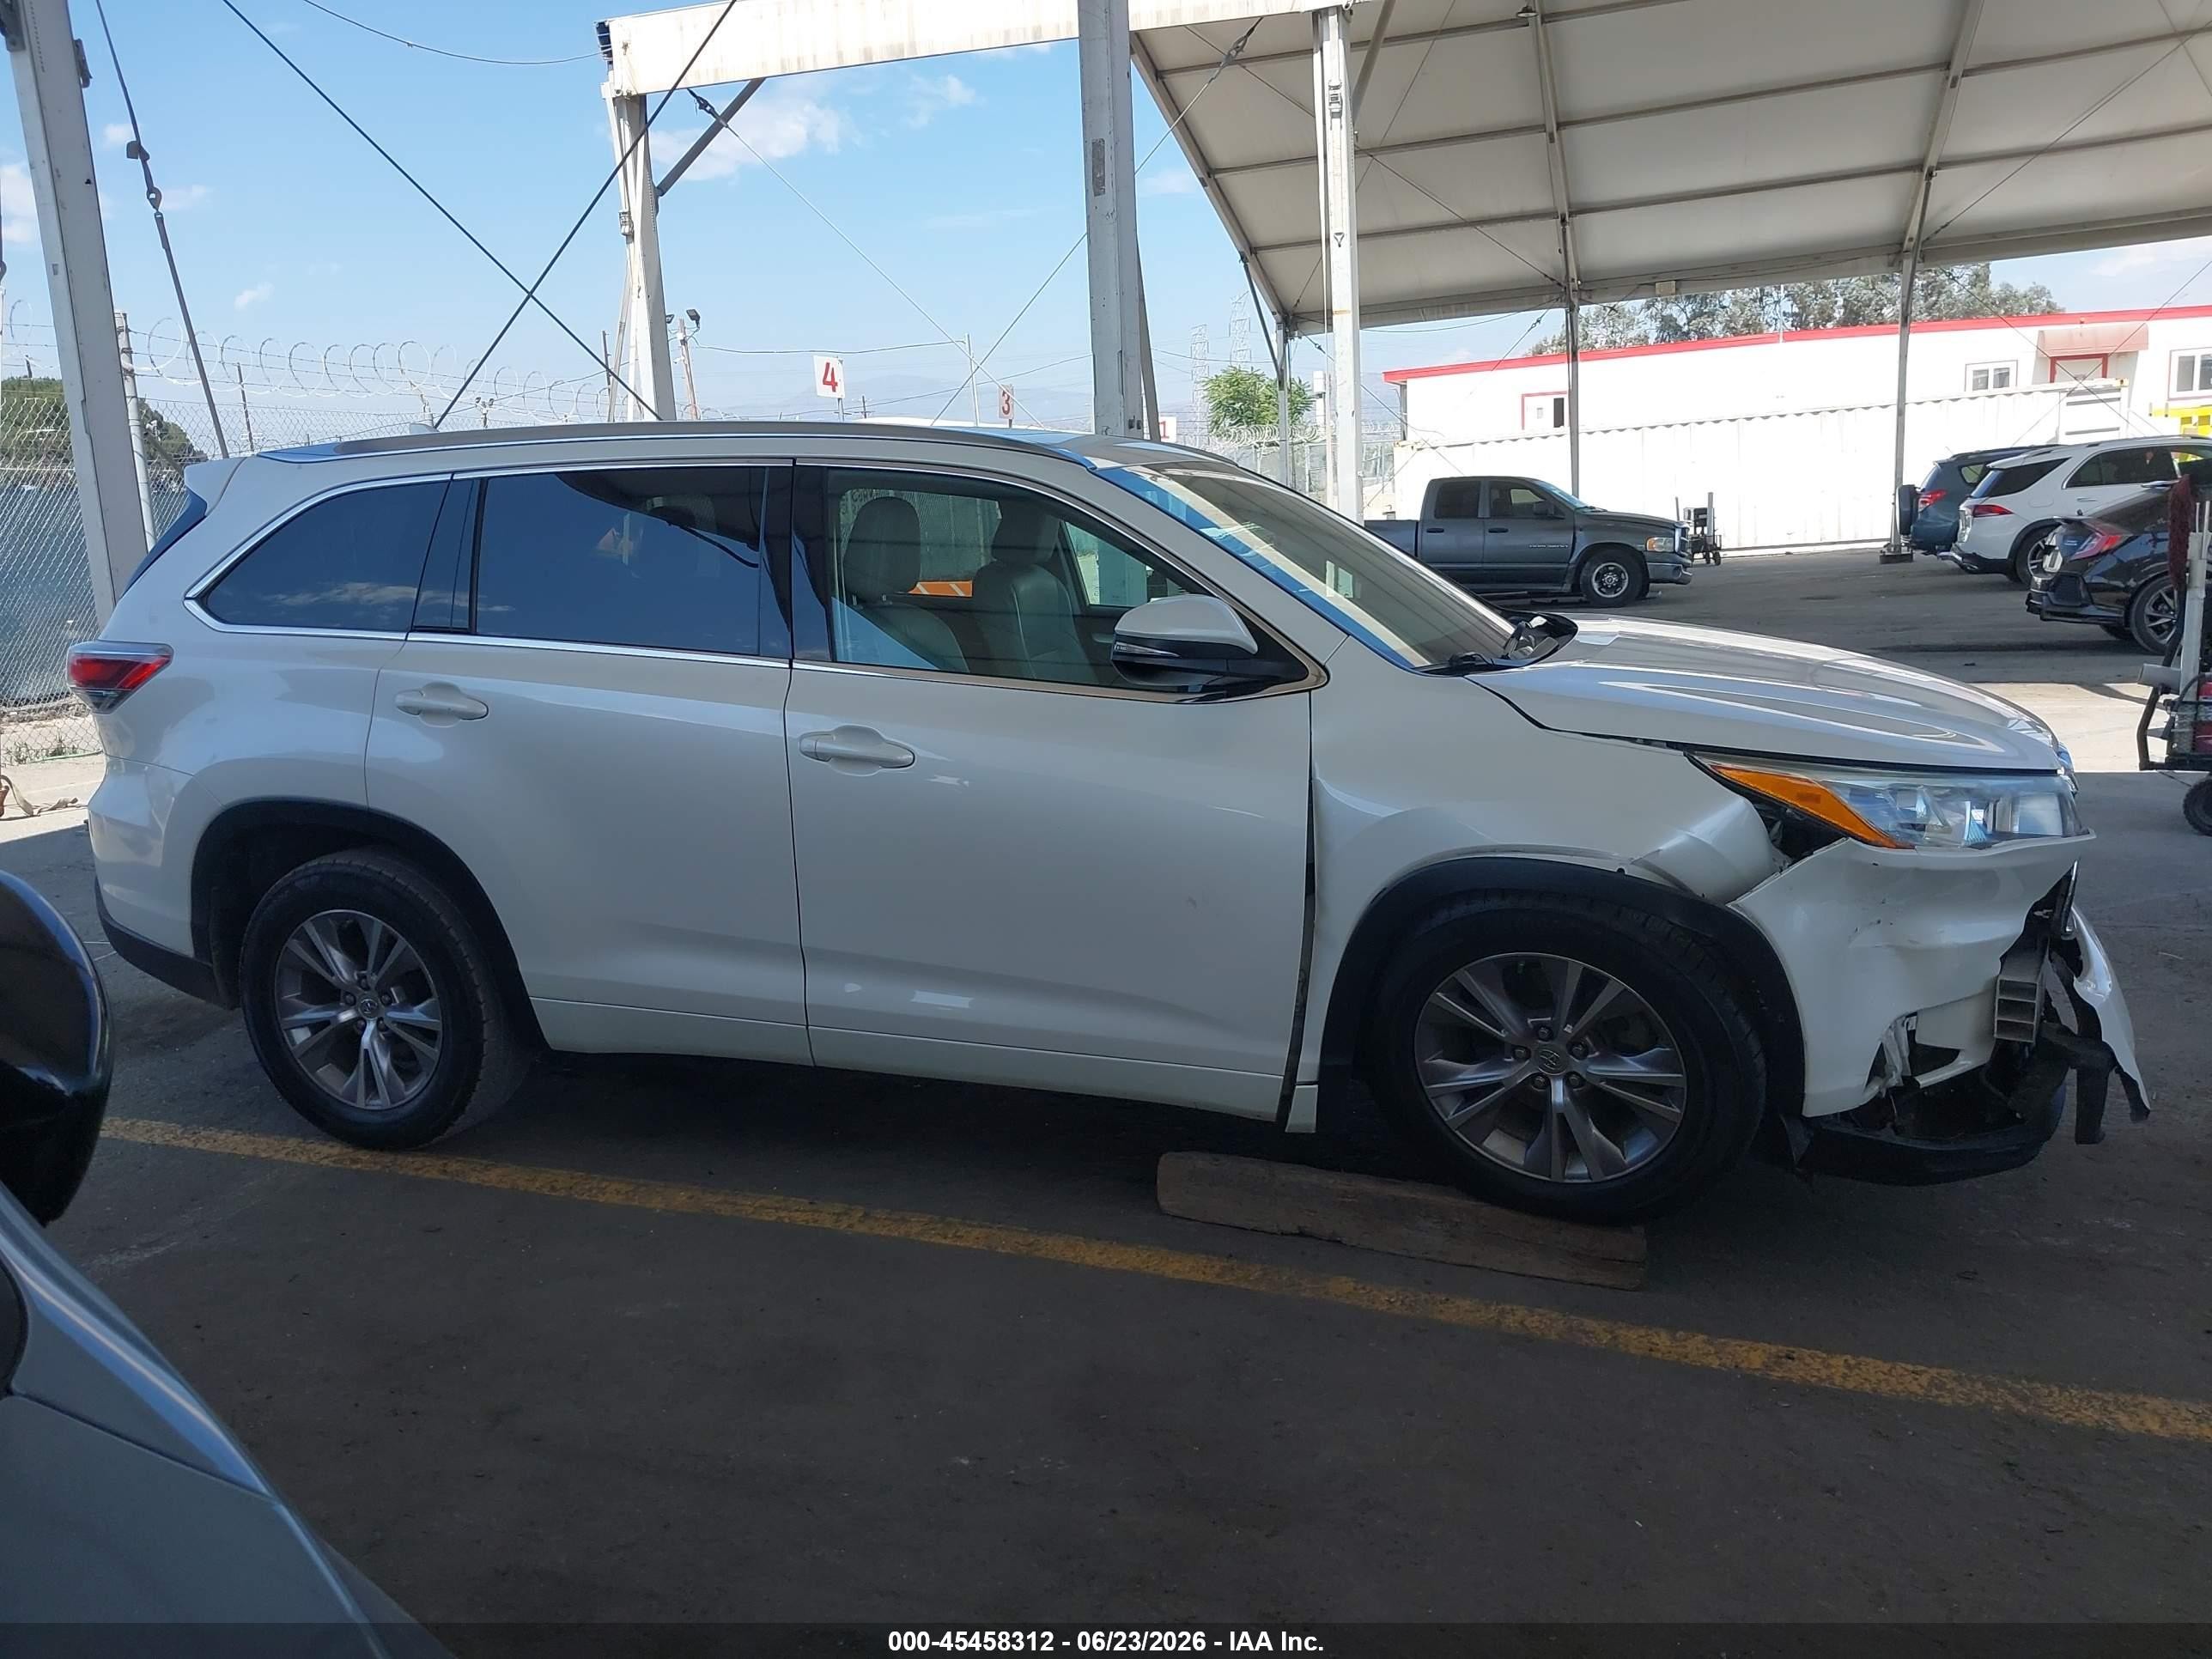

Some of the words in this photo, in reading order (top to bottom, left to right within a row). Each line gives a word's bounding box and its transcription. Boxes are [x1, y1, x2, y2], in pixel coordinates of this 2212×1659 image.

[822, 362, 839, 392] 4
[1002, 389, 1012, 416] 3
[1158, 420, 1170, 440] 1
